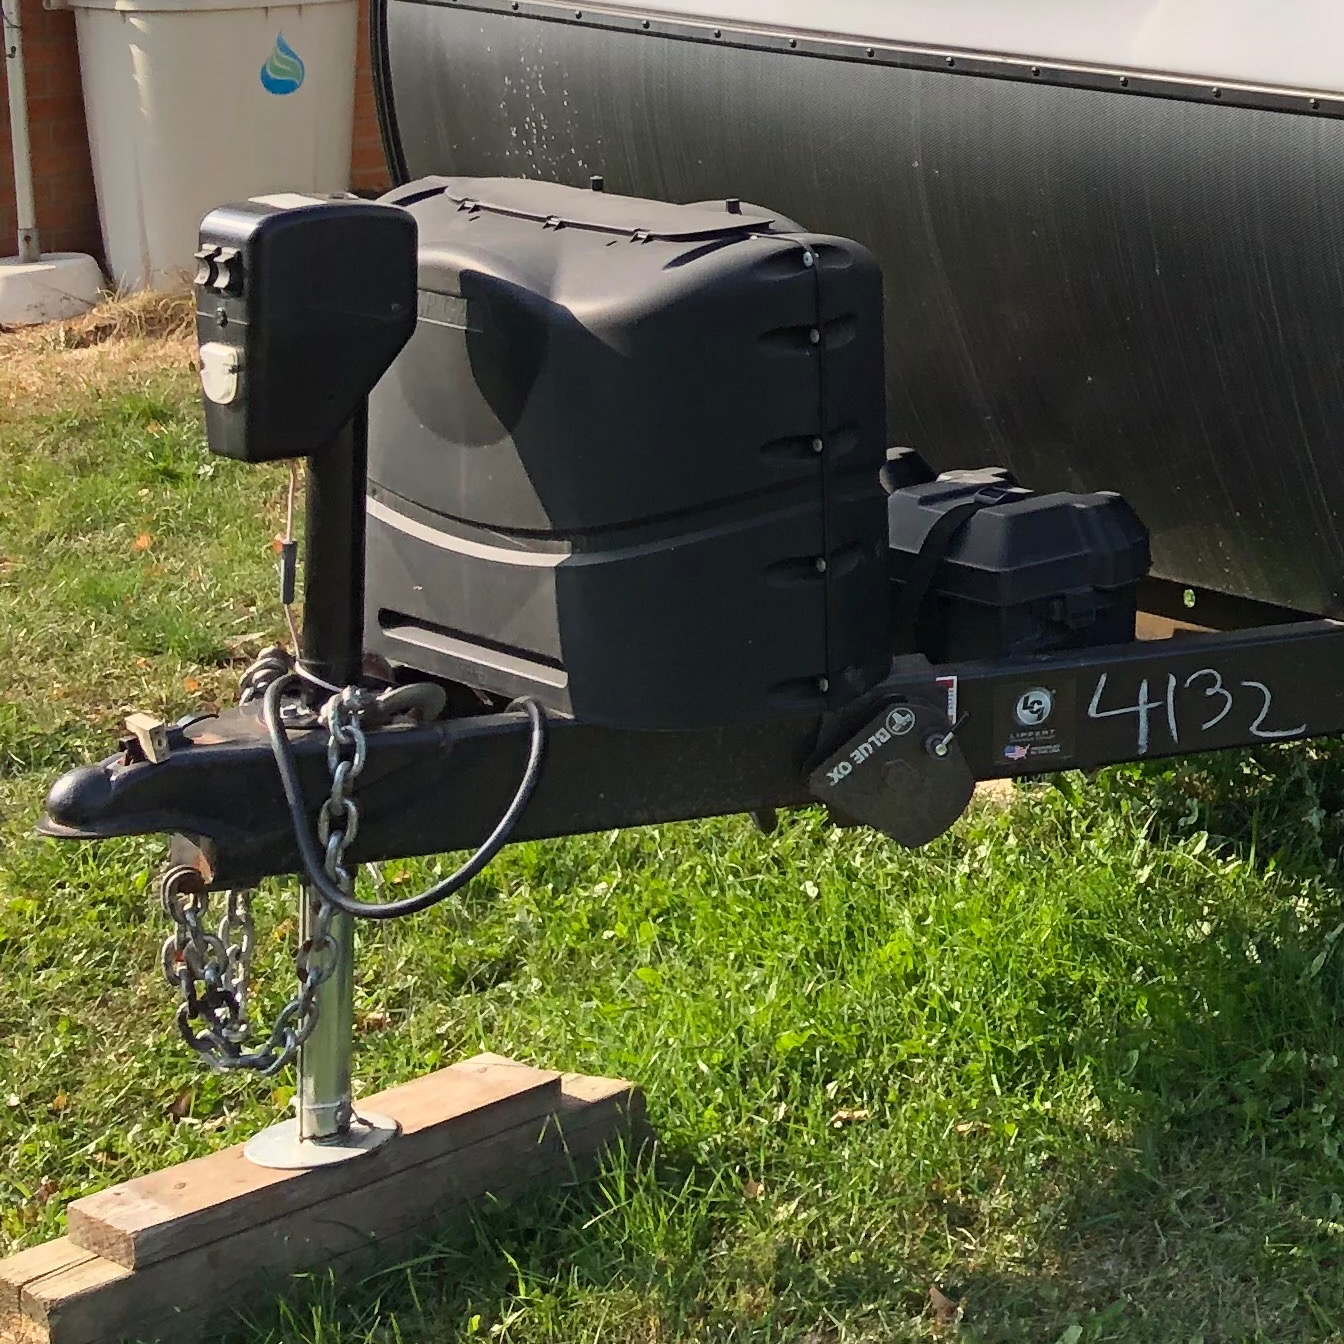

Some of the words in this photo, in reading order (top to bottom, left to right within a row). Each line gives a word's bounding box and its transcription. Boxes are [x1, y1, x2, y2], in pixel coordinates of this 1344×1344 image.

[1087, 668, 1306, 755] 4132
[850, 727, 892, 764] BLUE
[826, 761, 853, 785] OX
